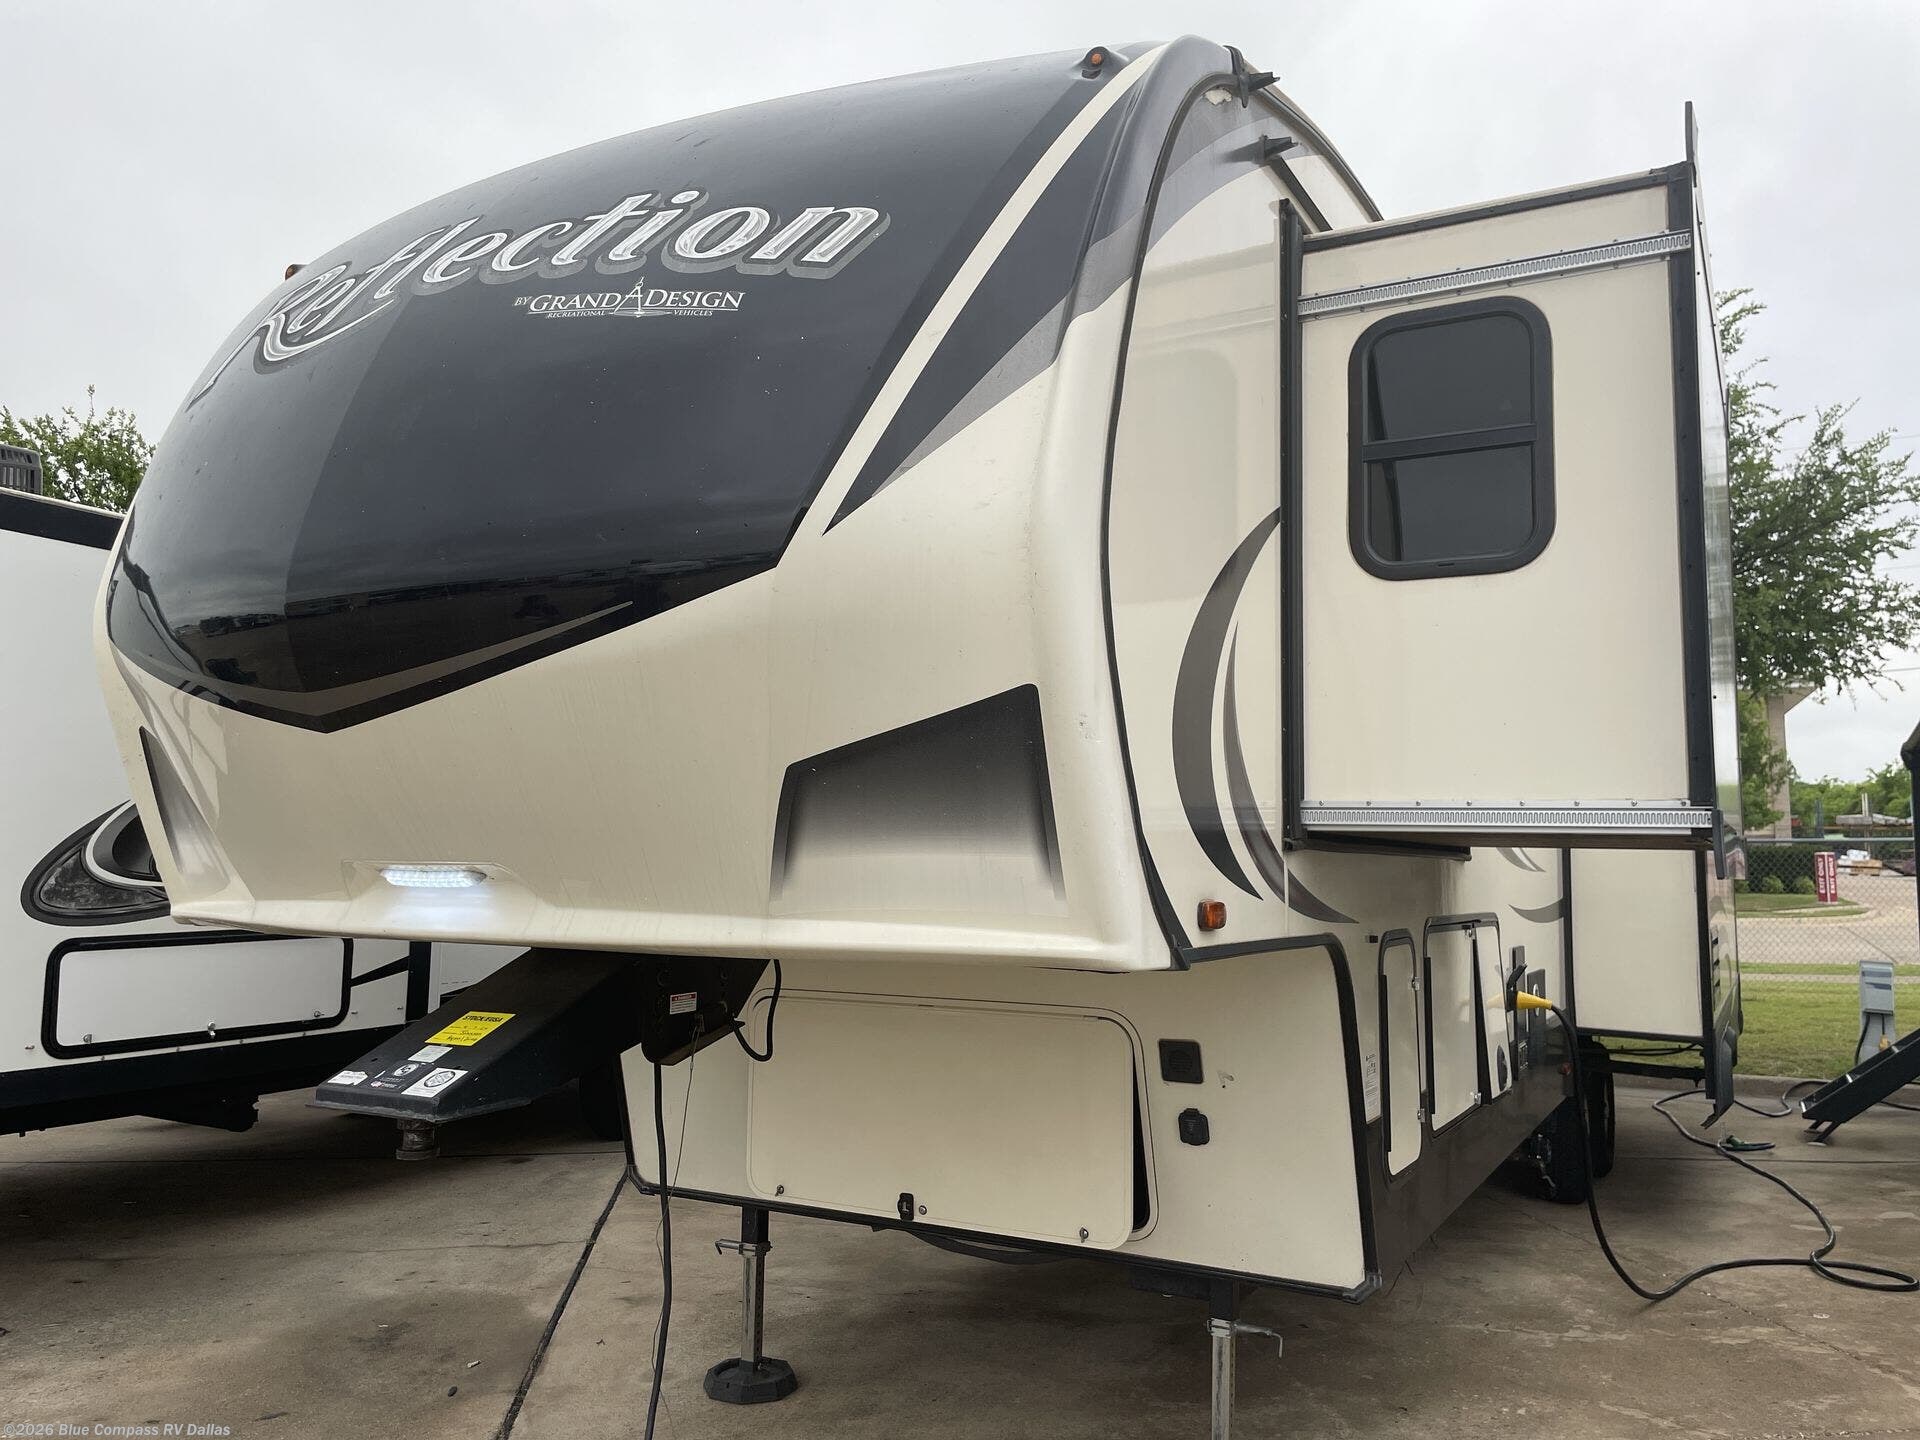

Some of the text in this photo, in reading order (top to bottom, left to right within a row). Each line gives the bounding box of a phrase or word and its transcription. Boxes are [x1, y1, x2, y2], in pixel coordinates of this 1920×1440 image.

[225, 188, 882, 372] Reflection
[513, 289, 745, 312] BY GRAND DESIGN
[547, 309, 713, 319] RECREATIONAL VEHICLES
